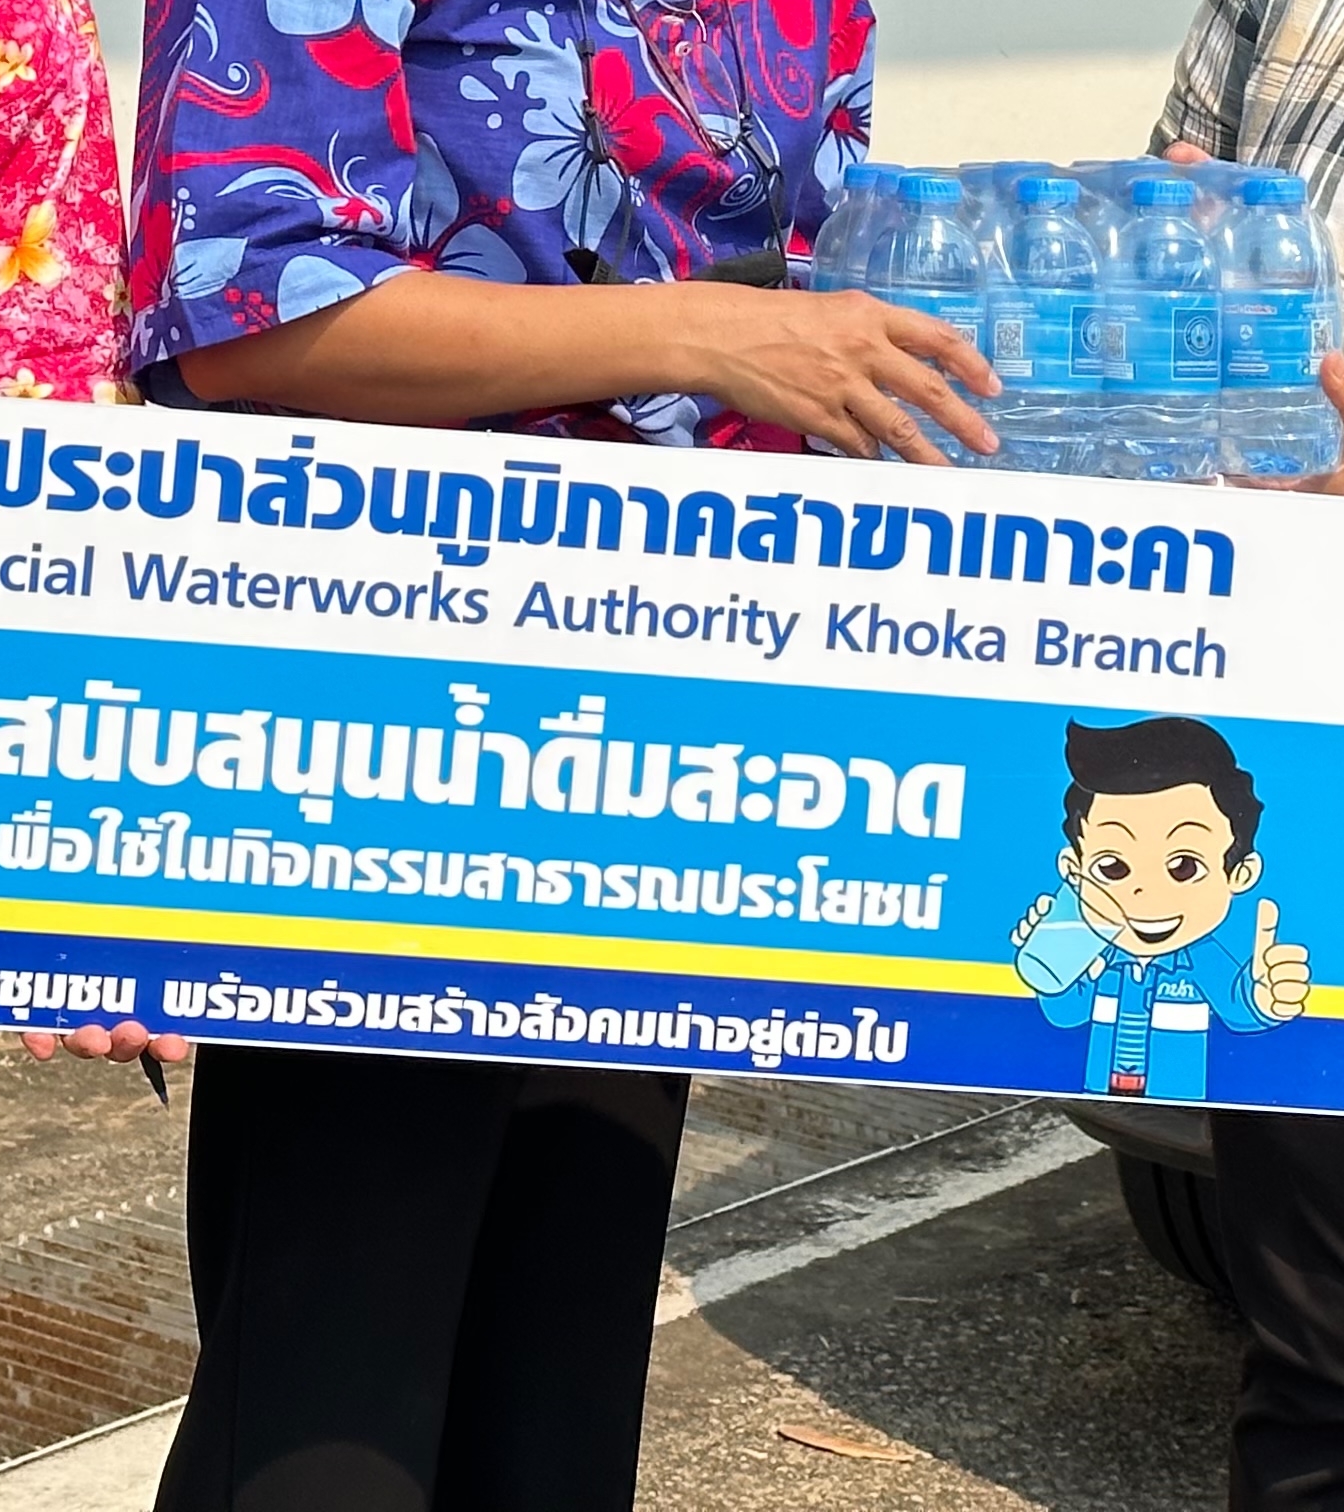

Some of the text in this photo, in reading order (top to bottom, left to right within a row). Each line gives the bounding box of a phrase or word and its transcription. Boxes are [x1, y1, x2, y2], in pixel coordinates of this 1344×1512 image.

[122, 551, 490, 626] Waterworks
[513, 580, 801, 661] Authority
[825, 602, 1007, 663] Khoka
[1034, 617, 1227, 679] Branch
[161, 971, 910, 1070] พร้อมร่วมสร้างสังคมน่าอยู่ต่อไป
